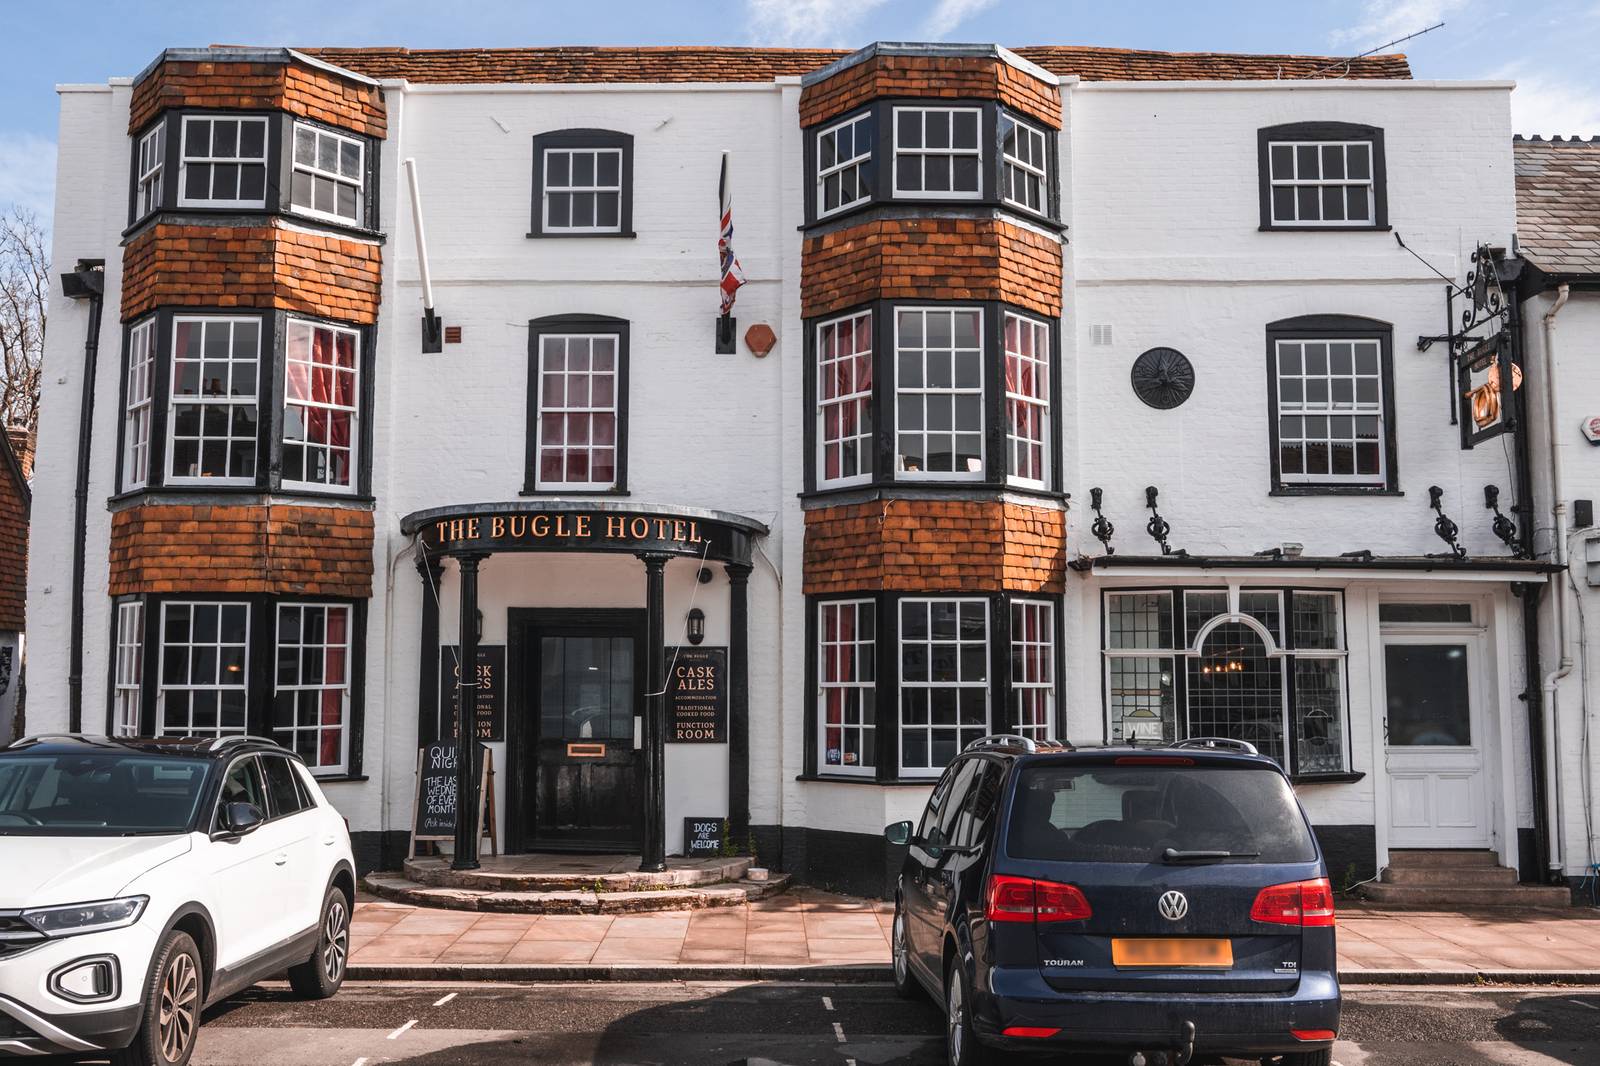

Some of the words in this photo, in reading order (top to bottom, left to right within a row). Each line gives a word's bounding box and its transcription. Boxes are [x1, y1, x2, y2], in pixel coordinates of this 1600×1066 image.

[436, 517, 480, 543] THE
[490, 515, 592, 538] BUGLE
[605, 516, 702, 543] HOTEL
[454, 665, 492, 677] CSK
[676, 666, 715, 678] CASK
[678, 679, 715, 690] ALES
[677, 729, 715, 739] ROOM
[1127, 722, 1160, 736] WINE
[430, 746, 457, 760] QUI
[424, 776, 443, 787] THE
[444, 775, 457, 787] LAS
[427, 785, 457, 795] WEDNE
[426, 795, 437, 805] OF
[694, 822, 718, 833] DOGS
[697, 832, 710, 840] ARE
[690, 839, 720, 849] WELCOME
[1043, 959, 1084, 967] TOURAN
